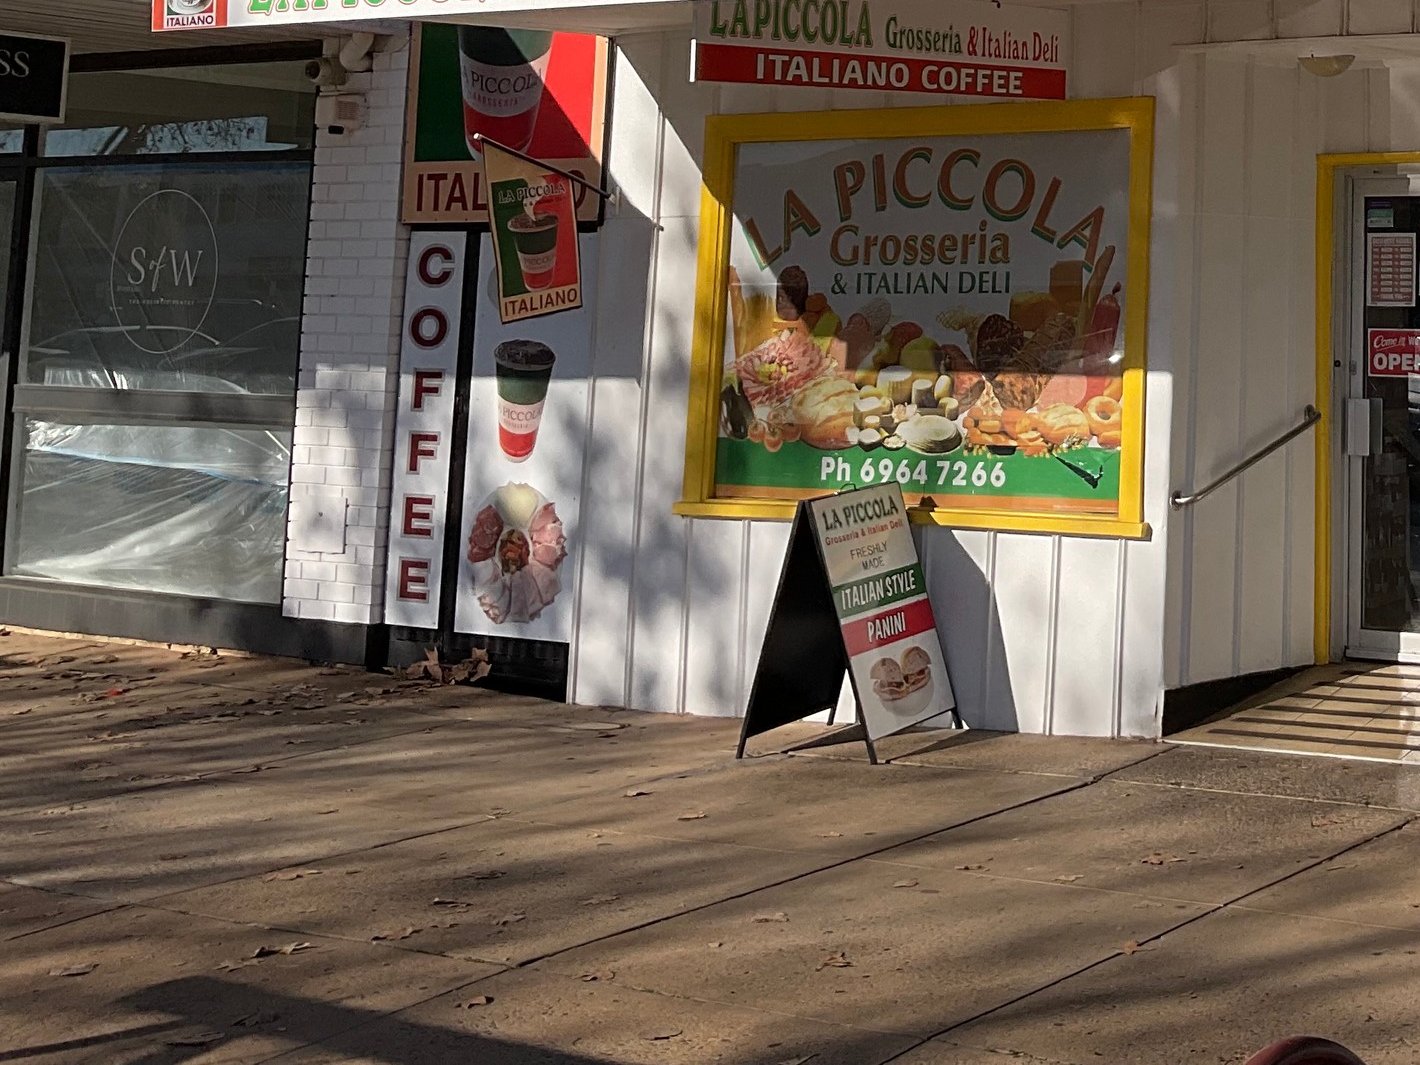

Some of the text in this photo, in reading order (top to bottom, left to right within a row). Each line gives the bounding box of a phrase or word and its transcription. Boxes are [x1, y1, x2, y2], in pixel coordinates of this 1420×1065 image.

[166, 15, 214, 27] ITALIANO
[885, 14, 962, 54] Grosseria
[1032, 31, 1059, 63] Deli
[755, 53, 1023, 95] ITALIANO COFFEE
[498, 189, 516, 204] LA
[516, 182, 567, 202] PICCOLA
[744, 146, 1105, 273] LA PICCOLA
[830, 219, 1011, 267] Grosseria
[831, 270, 1011, 295] & ITALIAN DELI
[504, 288, 578, 316] ITALIANO
[397, 243, 456, 604] COFFEE
[820, 456, 1006, 488] Ph 6964 7266
[822, 494, 899, 532] LA PICCOLA
[825, 529, 859, 546] Grosseria
[867, 524, 889, 536] Italian
[890, 519, 904, 531] Deli
[850, 540, 888, 560] FRESHLY
[862, 556, 885, 571] MADE
[841, 569, 916, 611] ITALIAN STYLE
[867, 611, 906, 643] PANINI
